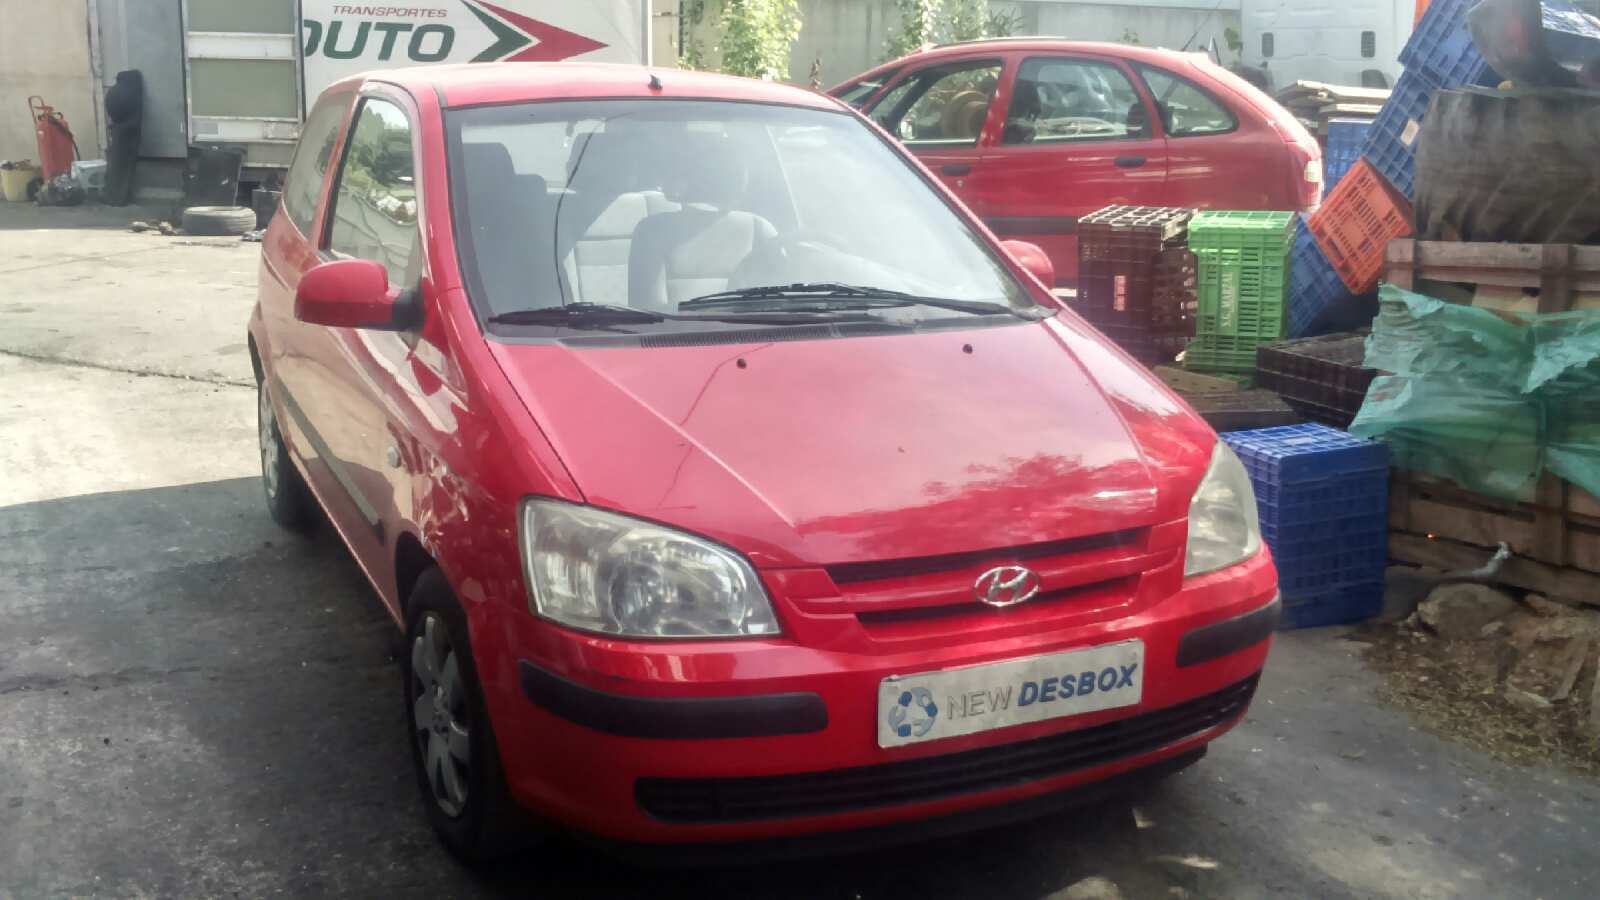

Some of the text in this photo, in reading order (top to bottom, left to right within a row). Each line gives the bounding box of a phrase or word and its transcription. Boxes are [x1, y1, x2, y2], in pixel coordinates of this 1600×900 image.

[334, 5, 448, 18] TRANSPORTES
[949, 665, 1137, 720] NEW DESBOX
